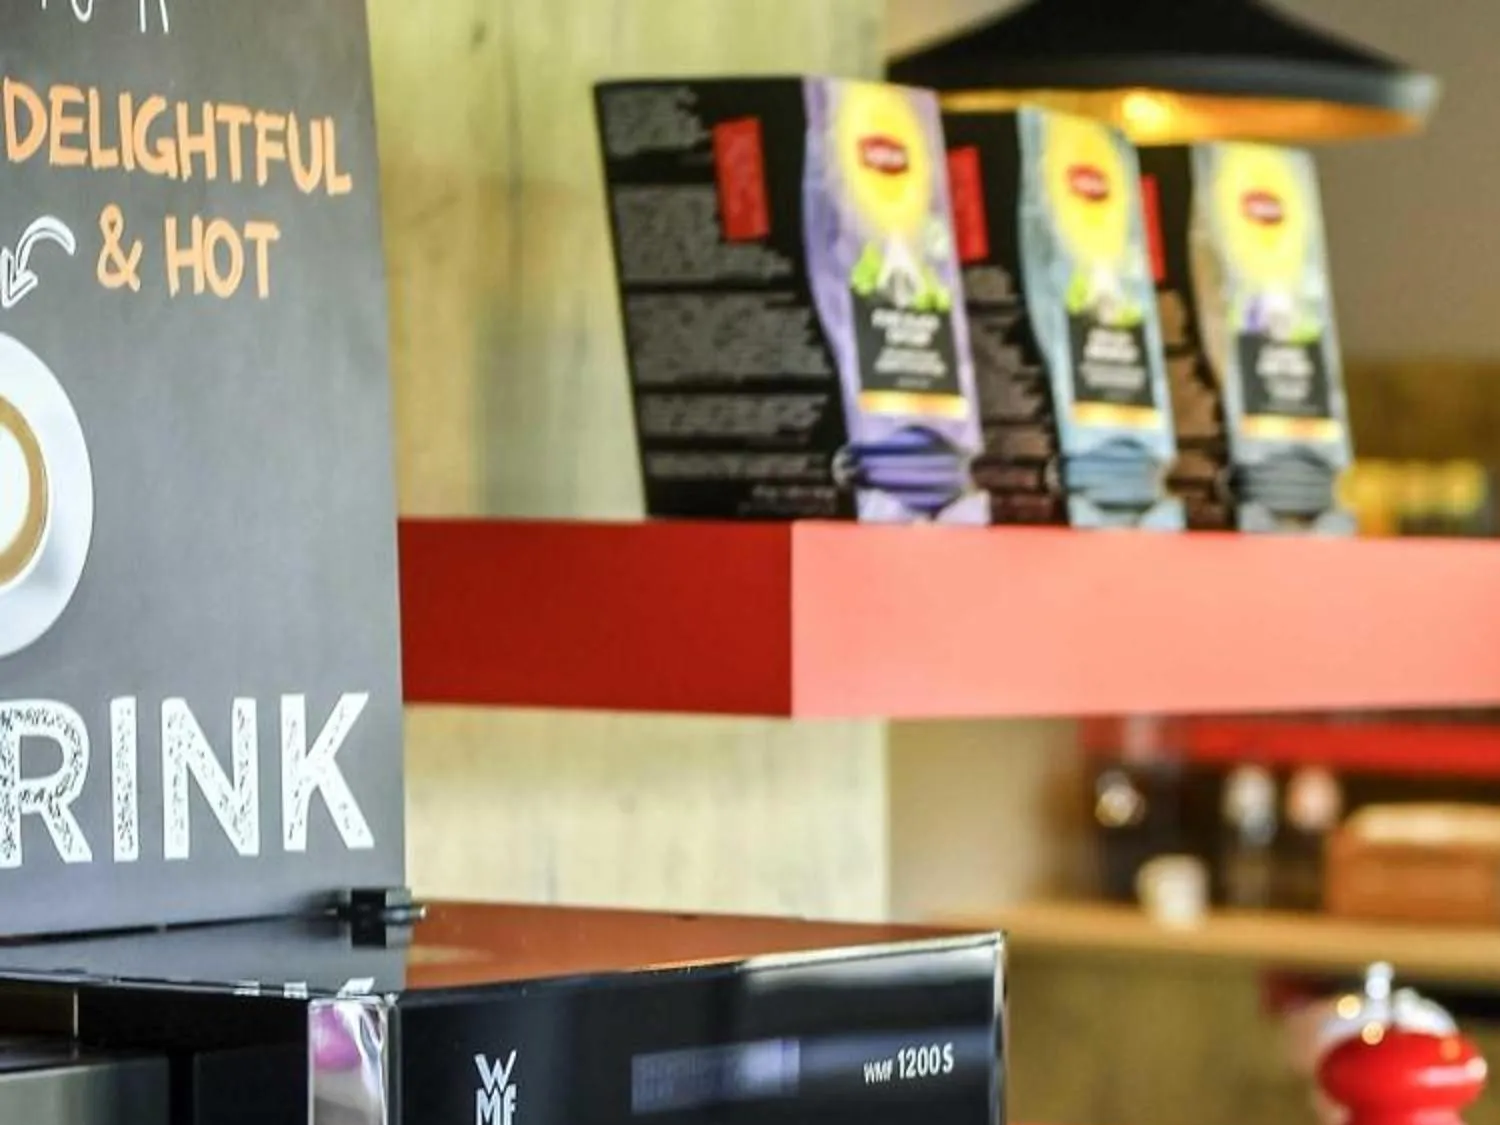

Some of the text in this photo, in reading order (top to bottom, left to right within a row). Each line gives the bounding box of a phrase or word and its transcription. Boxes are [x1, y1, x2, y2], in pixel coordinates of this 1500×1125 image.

[3, 76, 353, 196] DELIGHTFUL
[97, 203, 281, 300] & HOT
[0, 692, 375, 869] RINK
